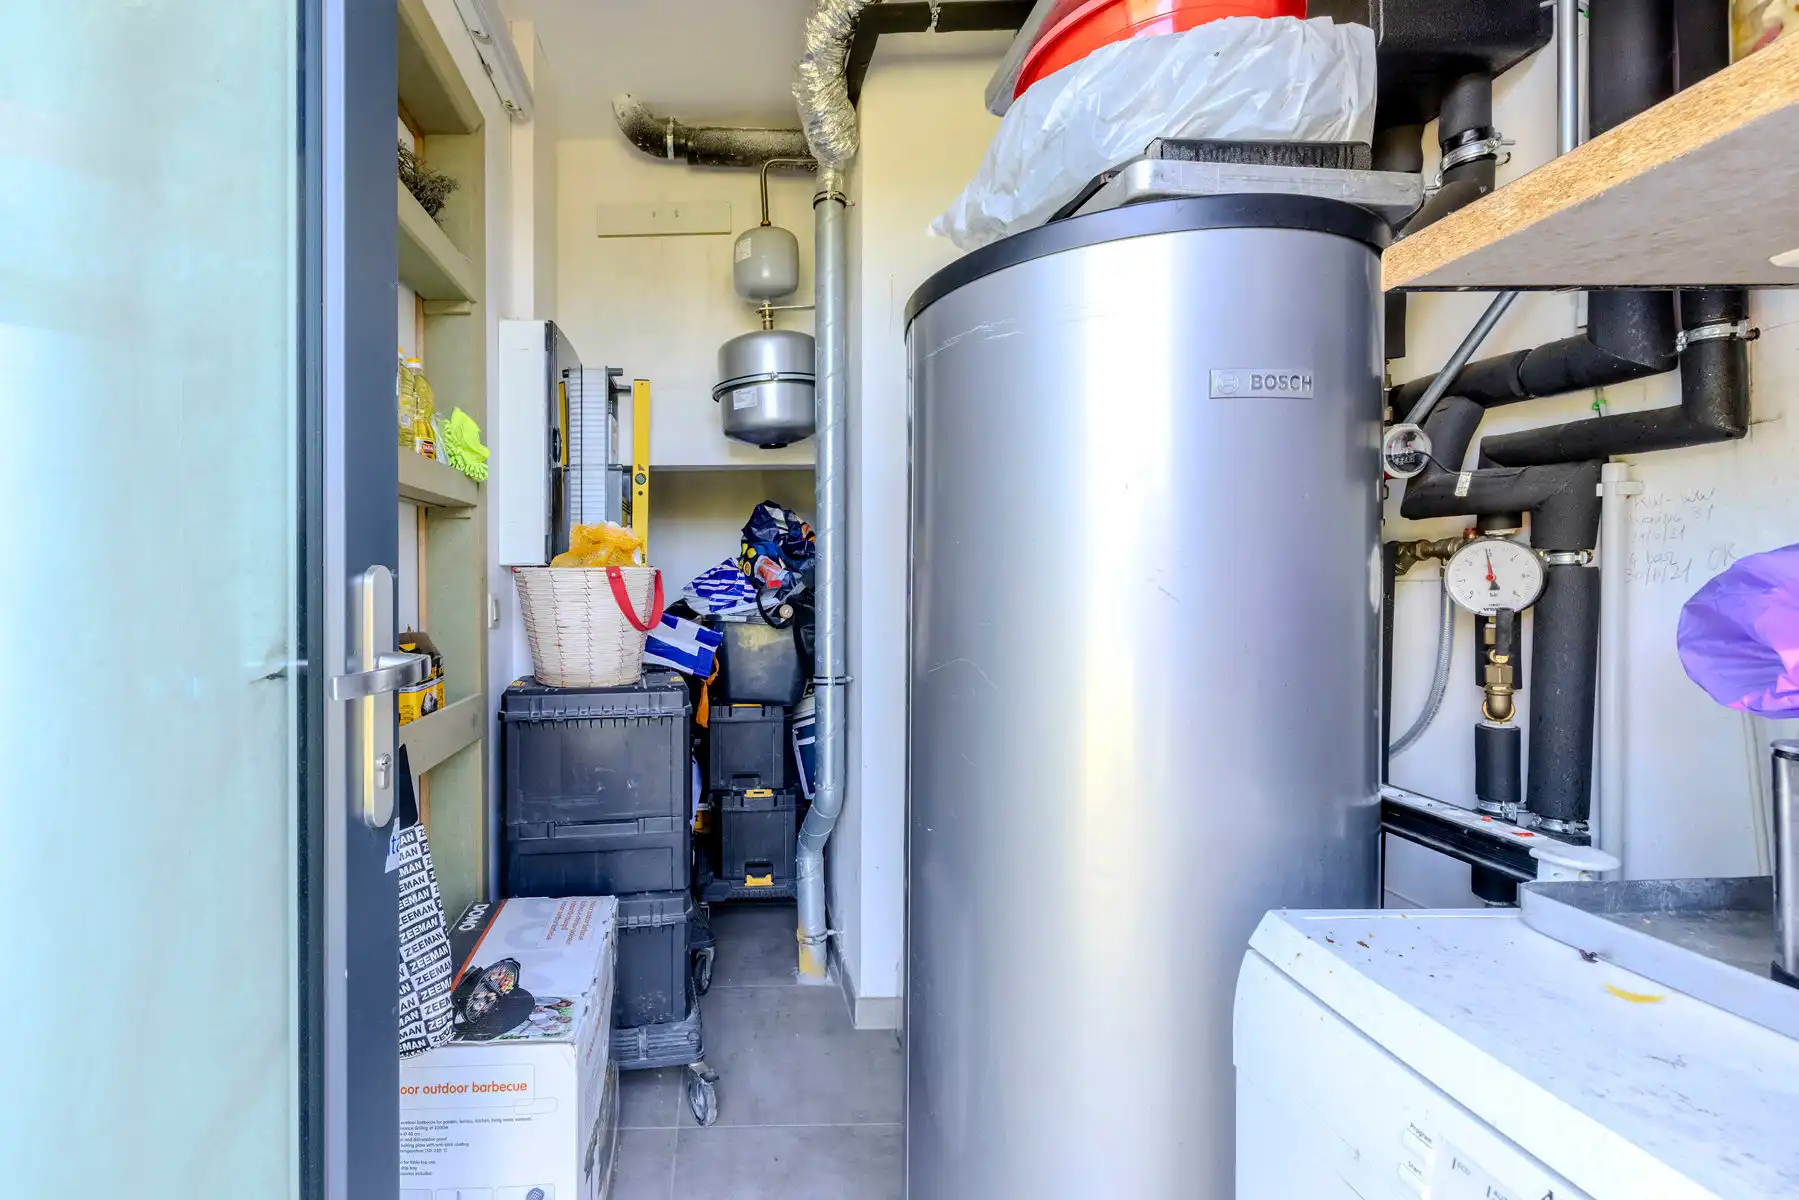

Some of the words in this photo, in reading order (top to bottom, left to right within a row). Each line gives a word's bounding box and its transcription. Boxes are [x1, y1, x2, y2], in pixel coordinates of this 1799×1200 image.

[1249, 373, 1312, 391] BOSCH
[1707, 542, 1737, 571] OK
[399, 857, 423, 877] MAN
[399, 874, 426, 894] EMAN
[399, 888, 430, 910] EEMAN
[400, 902, 435, 926] EEMAN
[458, 903, 490, 931] DOMO
[400, 917, 438, 943] ZEEMAN
[404, 932, 444, 957] ZEEMAN
[410, 944, 449, 972] ZEEMAN
[421, 977, 451, 1001] ZEEM
[400, 1024, 422, 1040] MAN
[399, 1039, 427, 1052] EMAN
[400, 1085, 419, 1095] oor
[423, 1082, 468, 1094] outdoor
[472, 1081, 527, 1093] barbecue
[1410, 1122, 1432, 1144] Program
